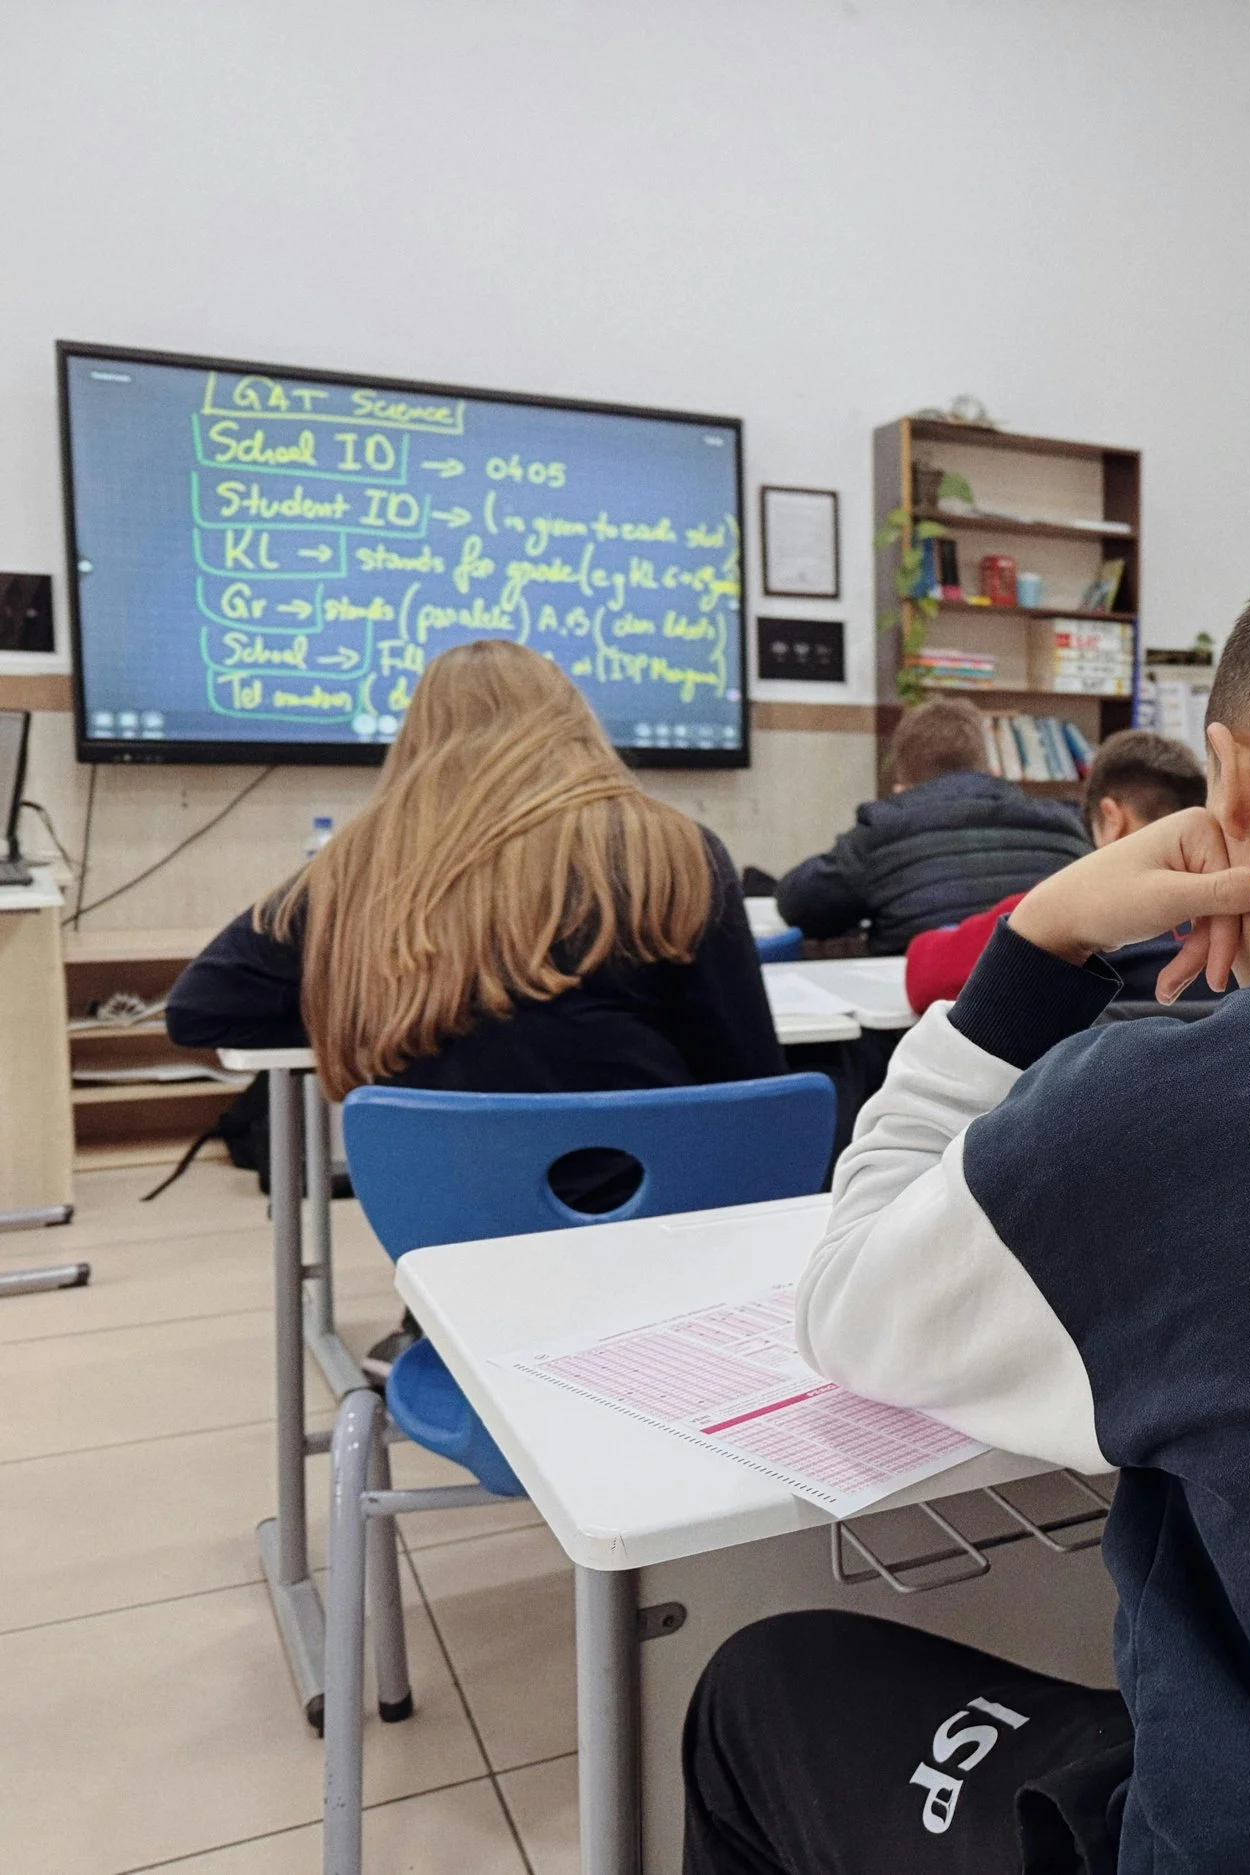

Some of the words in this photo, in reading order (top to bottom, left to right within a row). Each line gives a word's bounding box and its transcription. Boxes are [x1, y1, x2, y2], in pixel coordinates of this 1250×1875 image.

[208, 420, 317, 466] School
[335, 431, 395, 472] ID
[215, 481, 350, 518] Student
[359, 488, 420, 527] ID
[220, 582, 268, 619] Gr
[223, 631, 307, 670] School
[909, 1696, 1031, 1834] ISP
